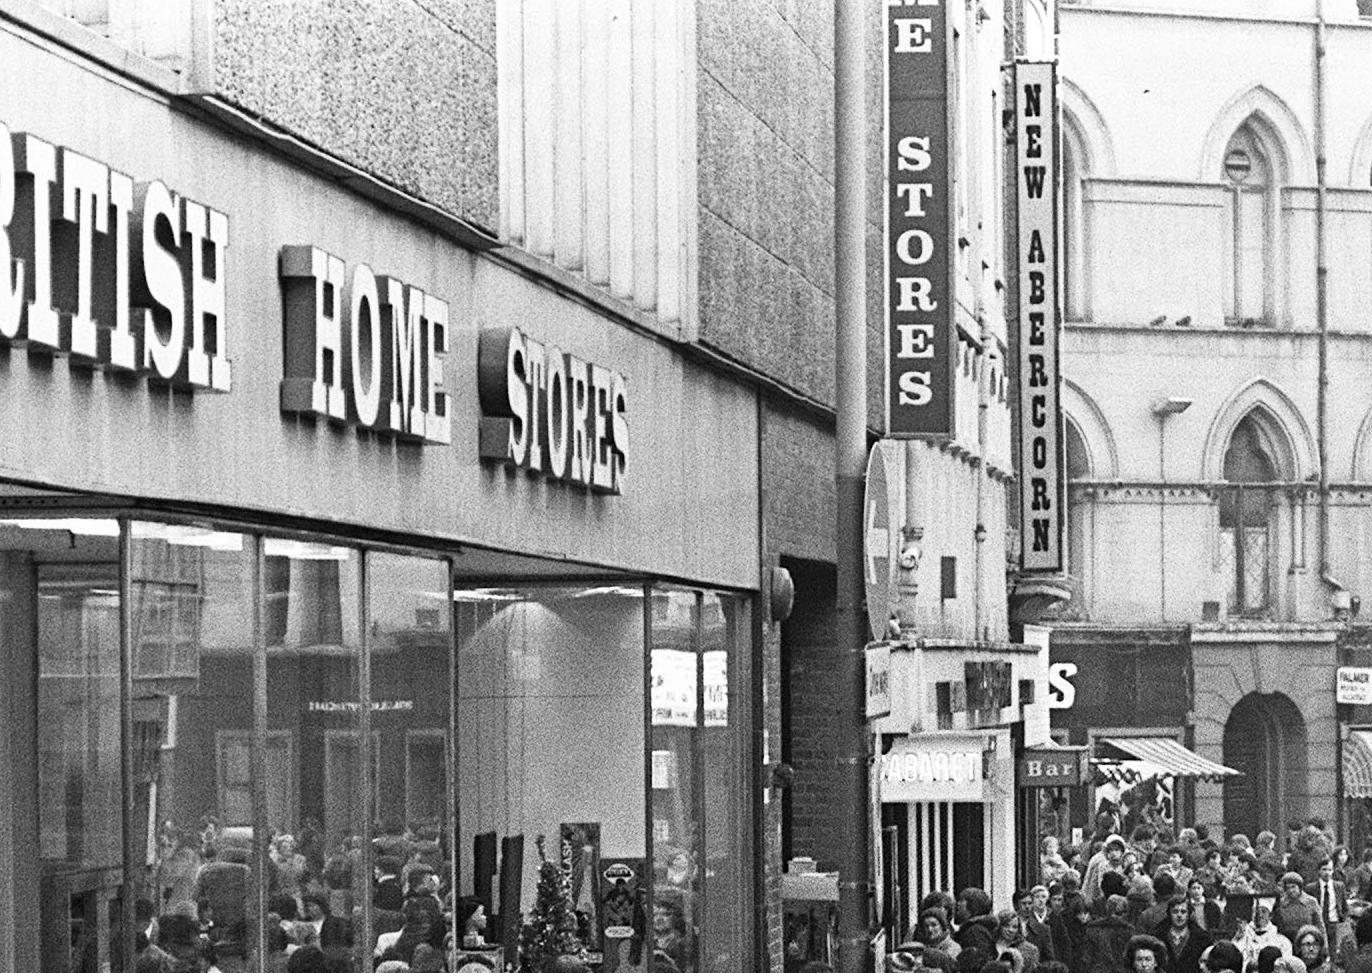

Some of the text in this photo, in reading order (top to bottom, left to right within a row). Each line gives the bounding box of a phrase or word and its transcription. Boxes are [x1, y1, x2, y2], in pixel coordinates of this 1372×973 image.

[890, 0, 938, 406] E STORES
[1023, 84, 1051, 553] NEW ABERCORN
[310, 245, 451, 445] HOME
[507, 327, 630, 496] STORES
[1026, 759, 1073, 777] Bar
